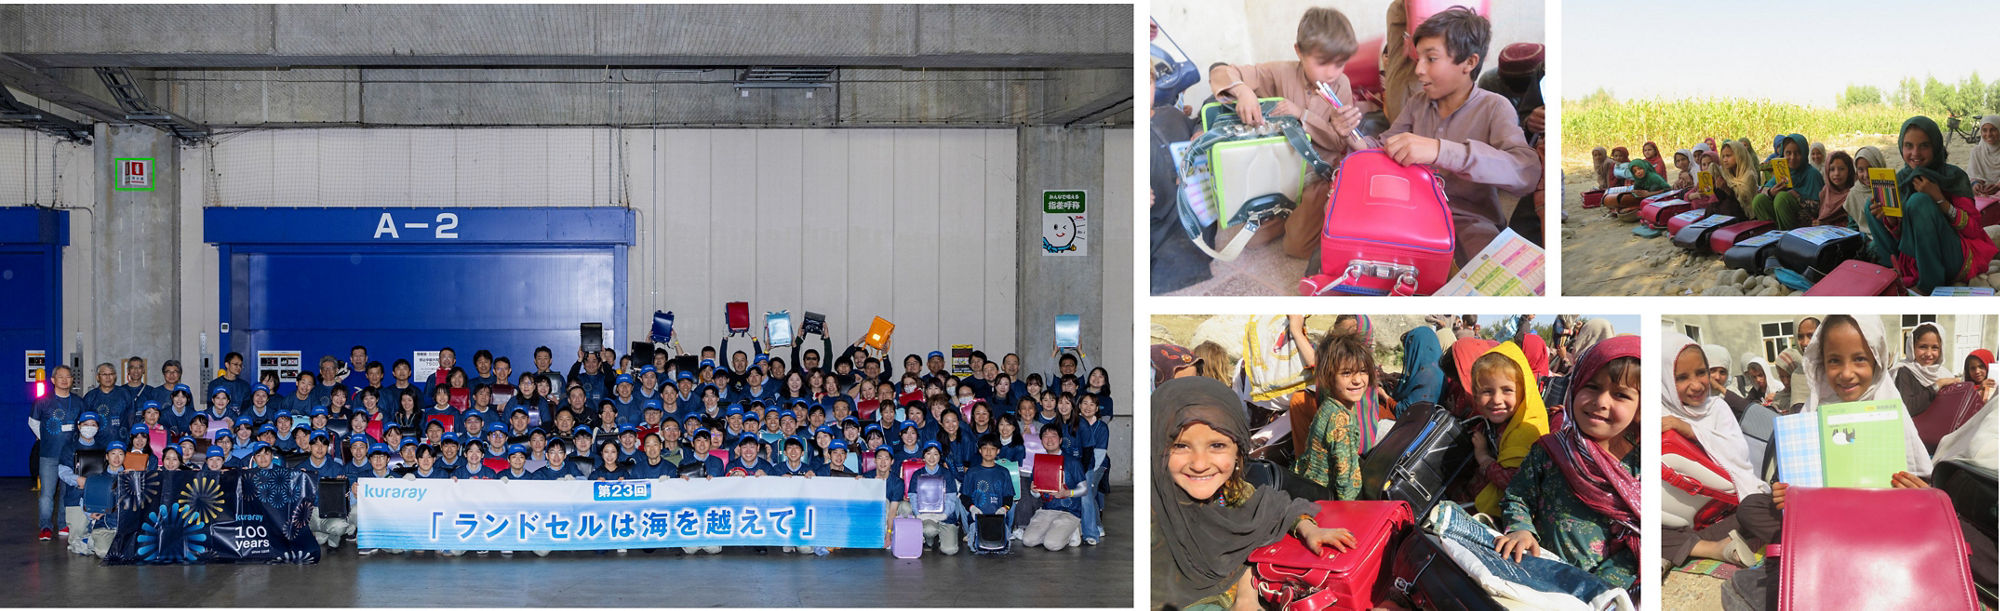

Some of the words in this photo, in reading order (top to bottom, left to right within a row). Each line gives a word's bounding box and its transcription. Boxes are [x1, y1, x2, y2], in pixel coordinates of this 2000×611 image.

[364, 484, 428, 502] kuraray
[597, 485, 648, 498] 第23回
[236, 513, 263, 522] kuraray
[432, 508, 813, 540] 「ランドセルは海を越えて」
[235, 525, 267, 538] 100
[235, 539, 270, 552] years
